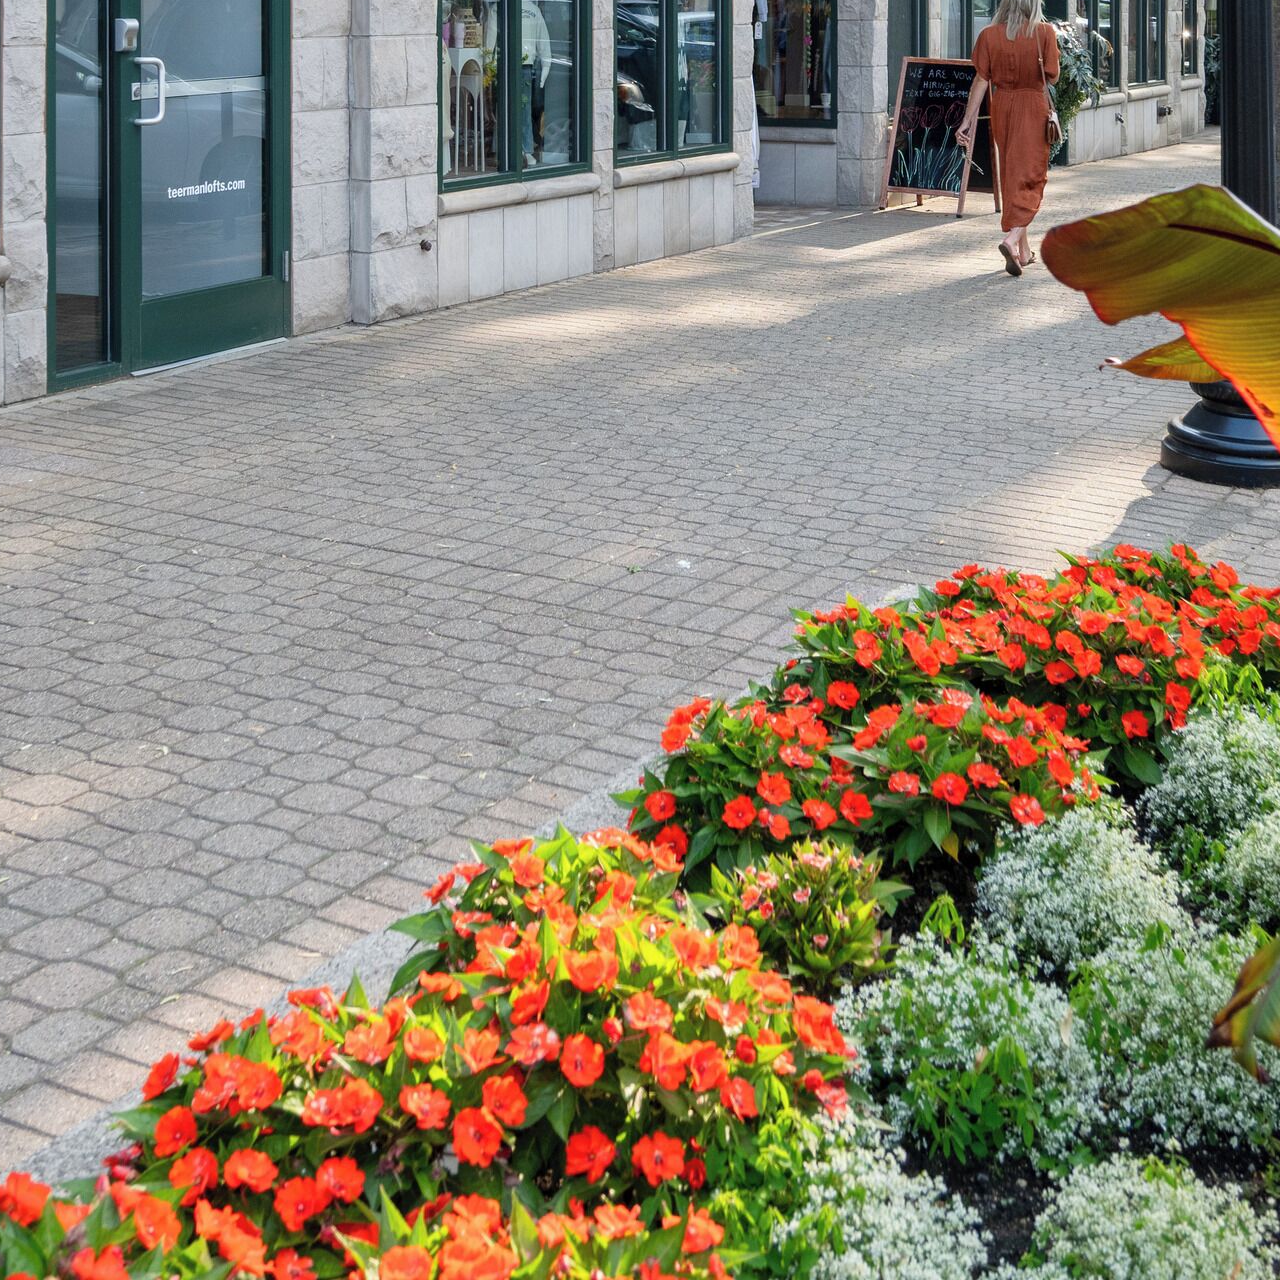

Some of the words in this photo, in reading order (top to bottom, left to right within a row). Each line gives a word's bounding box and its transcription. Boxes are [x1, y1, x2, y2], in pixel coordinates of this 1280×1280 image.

[909, 68, 923, 79] WE
[928, 69, 948, 79] ARE
[905, 89, 924, 98] TEXT
[167, 178, 246, 200] teermanlofts.com
